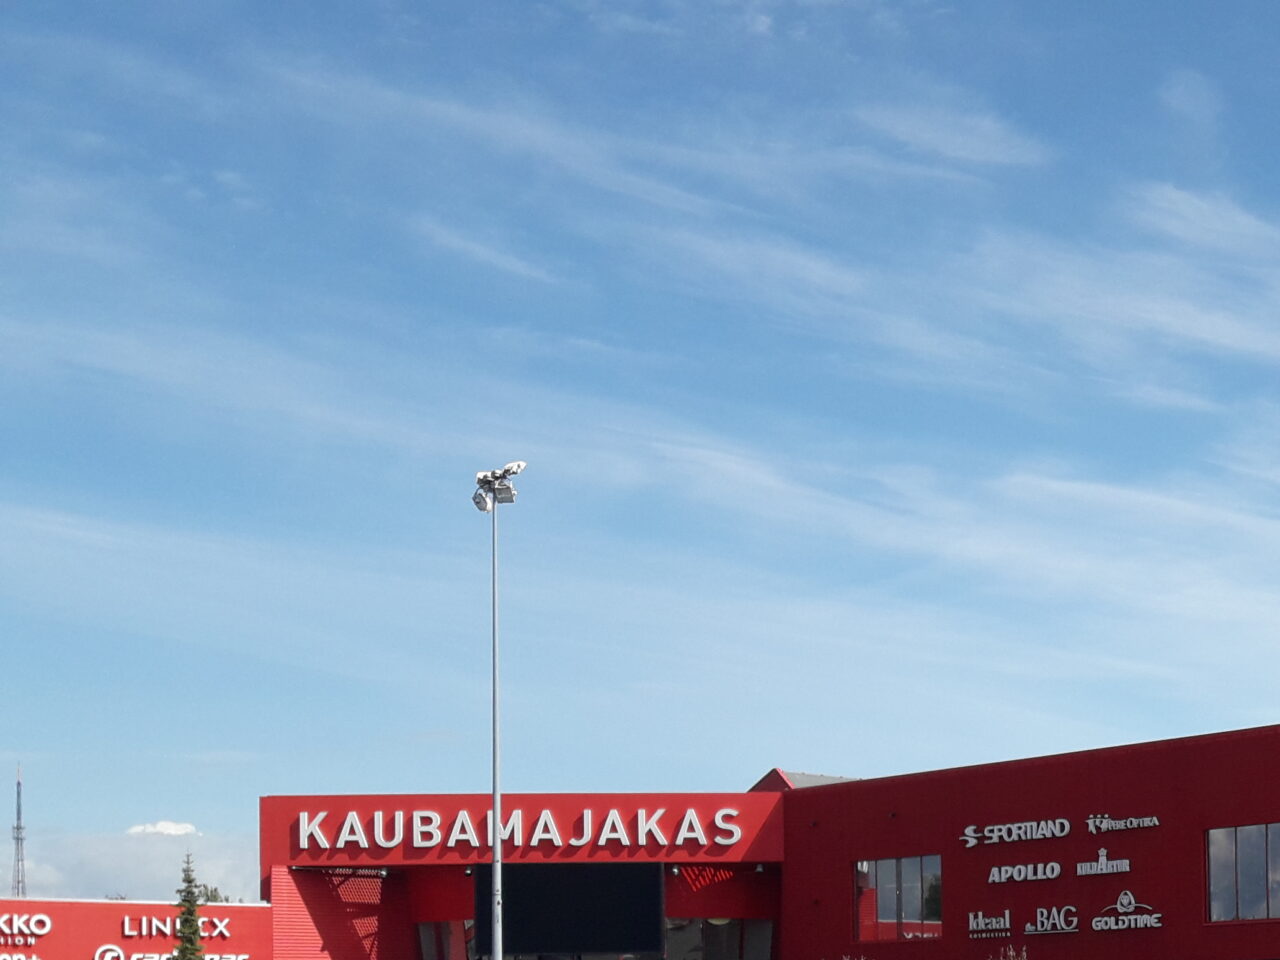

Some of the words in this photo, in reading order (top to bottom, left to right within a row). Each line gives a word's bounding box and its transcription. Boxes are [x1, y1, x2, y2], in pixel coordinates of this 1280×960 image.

[299, 808, 743, 849] KAUBAMAJAKAS
[983, 818, 1070, 844] SPORTLAND
[988, 861, 1061, 883] APOLLO
[124, 915, 230, 937] LINEX
[968, 909, 1010, 931] Ideaal
[1037, 905, 1078, 931] BAG
[1092, 913, 1162, 931] GOLDTIME
